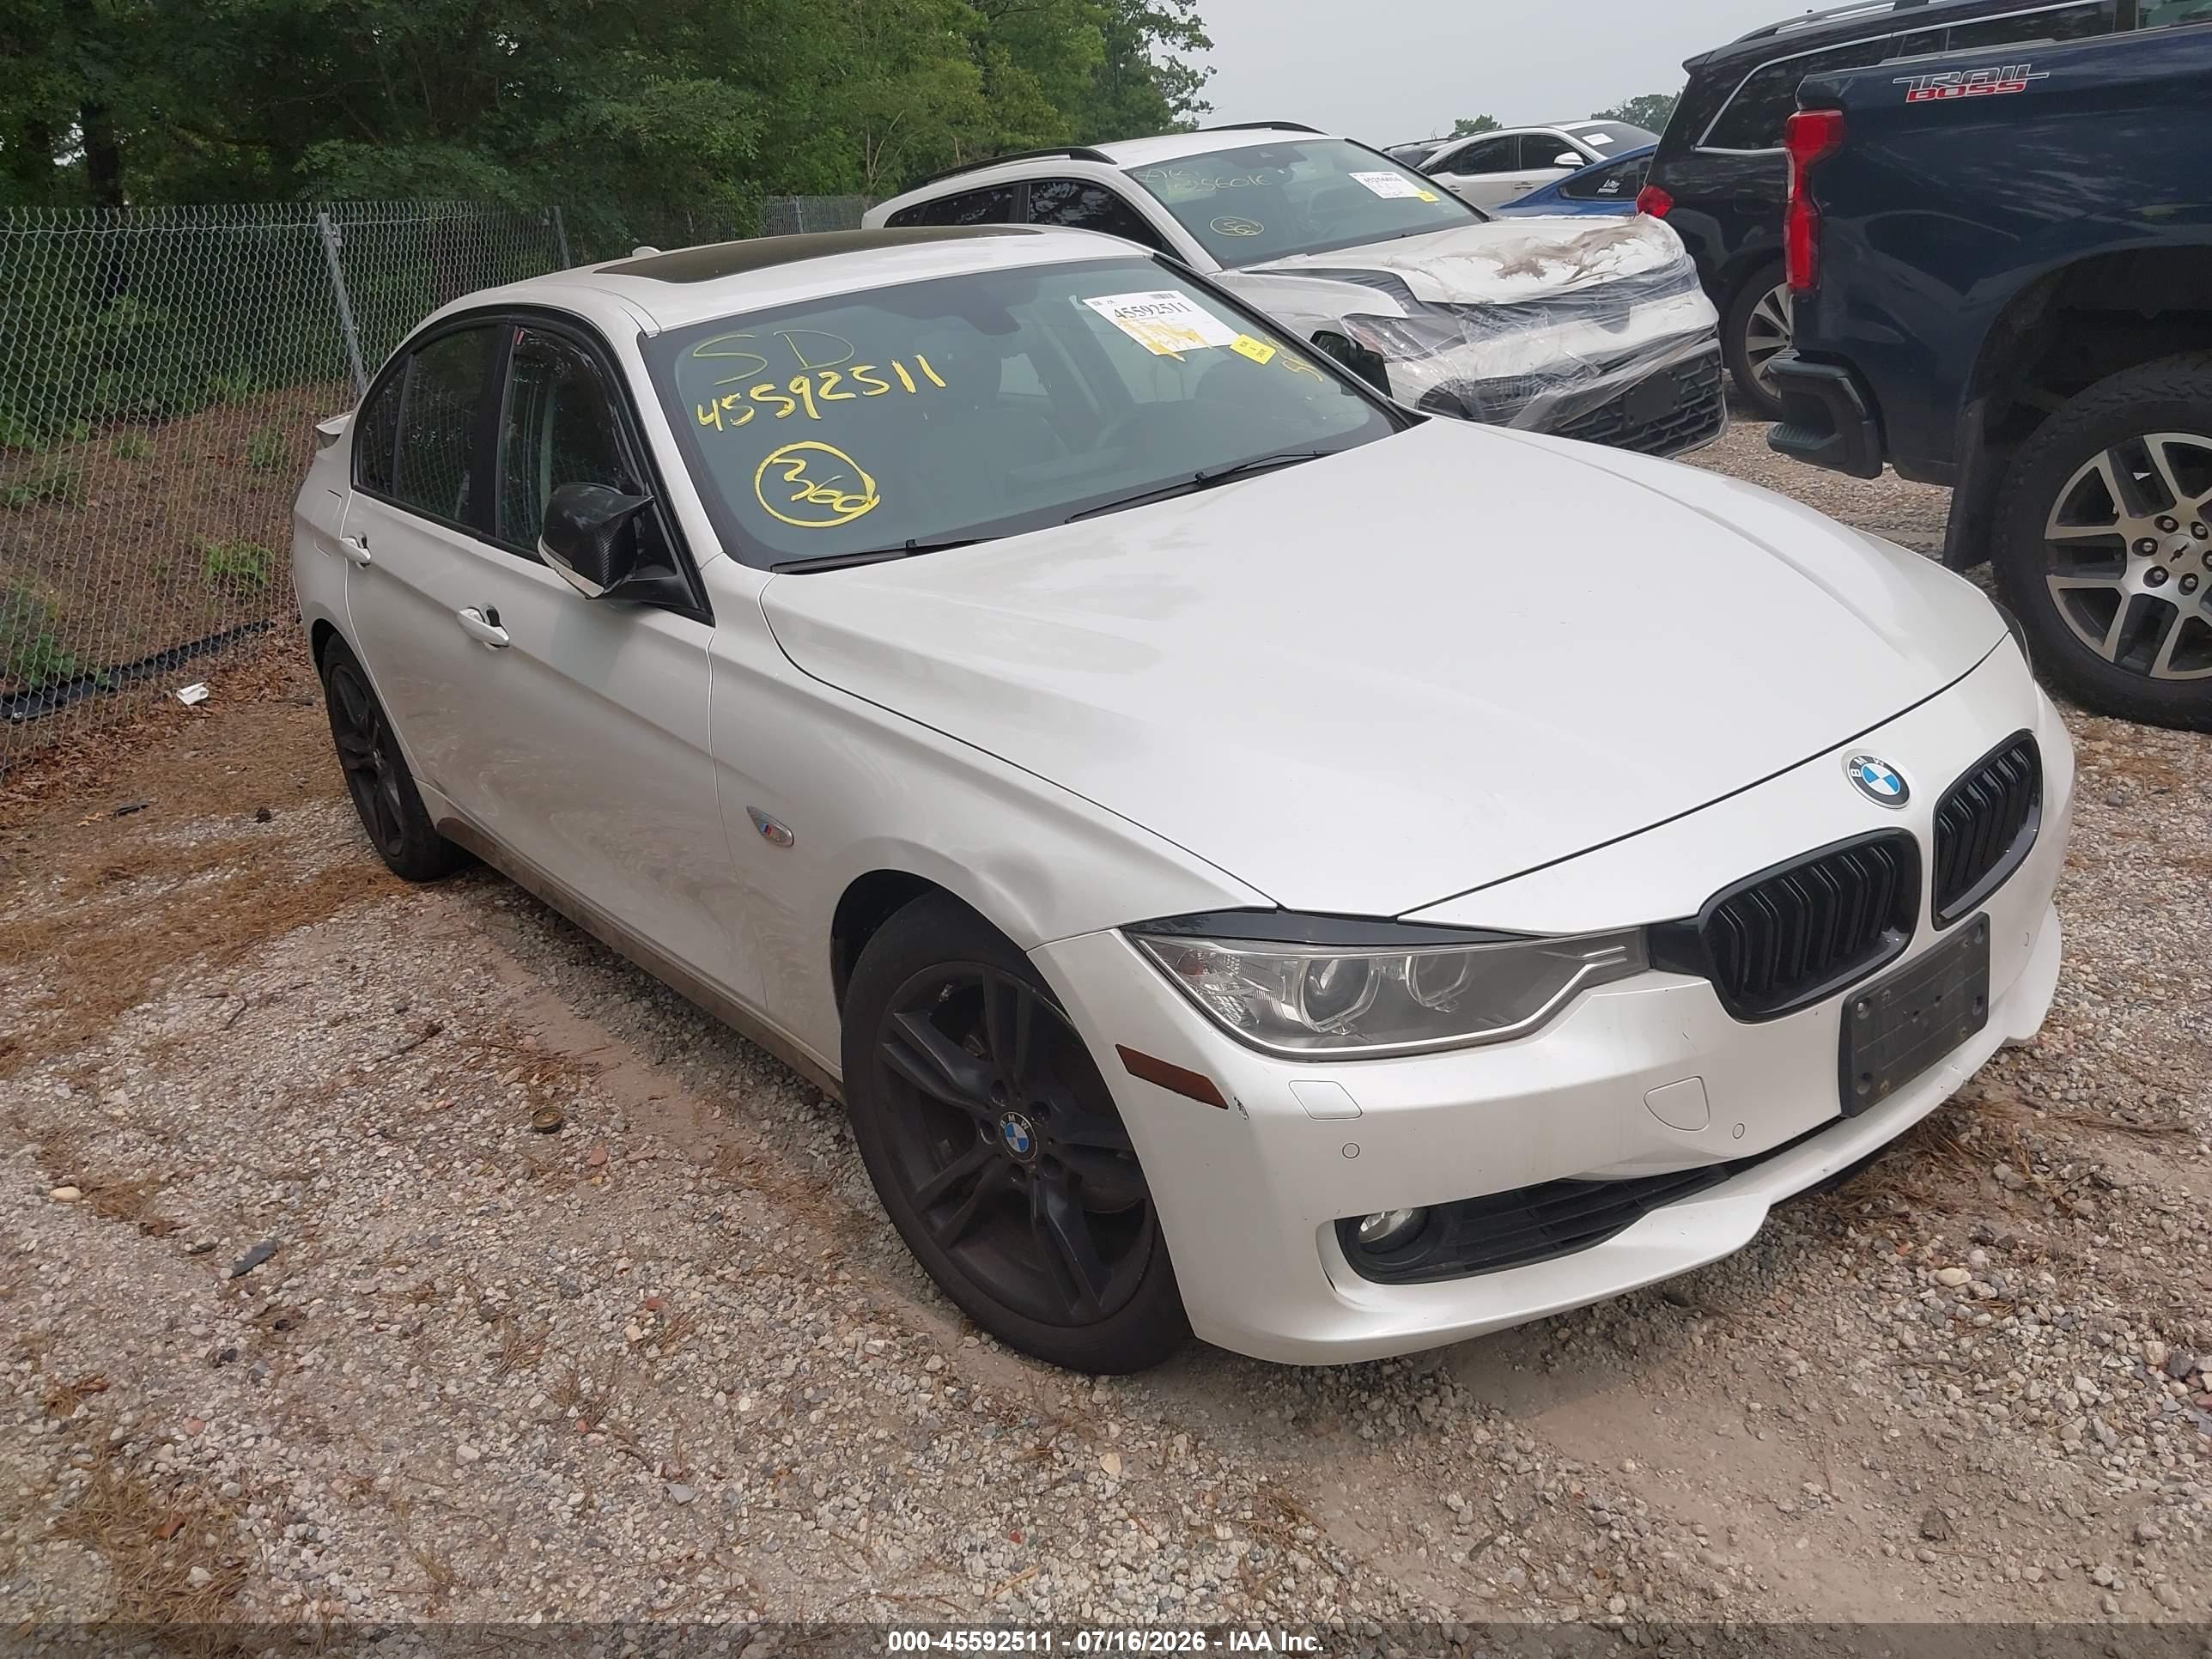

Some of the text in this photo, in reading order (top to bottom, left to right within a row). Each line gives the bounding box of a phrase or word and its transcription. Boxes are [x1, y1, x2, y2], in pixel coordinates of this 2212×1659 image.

[1893, 64, 2050, 90] TRAIL
[1905, 80, 2027, 103] BOSS
[1114, 301, 1193, 319] 45592511
[696, 354, 947, 432] 45592511
